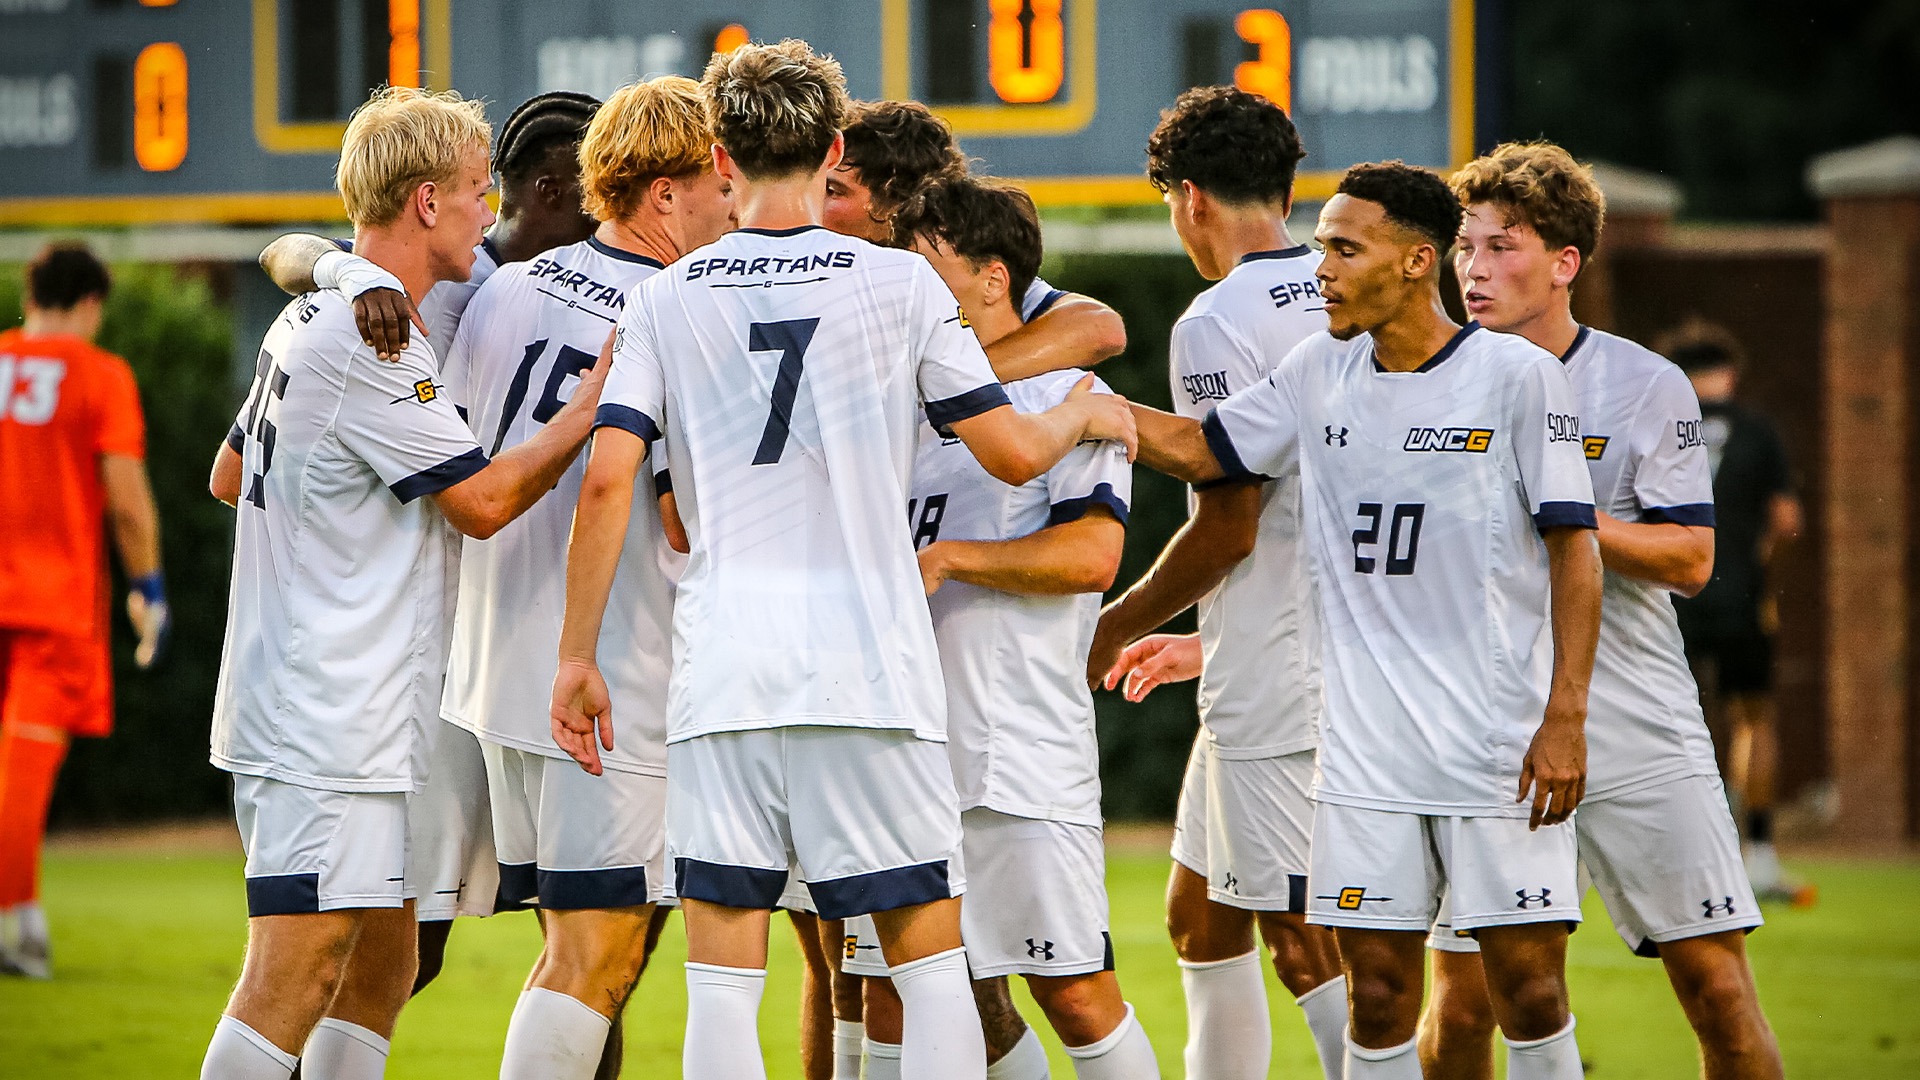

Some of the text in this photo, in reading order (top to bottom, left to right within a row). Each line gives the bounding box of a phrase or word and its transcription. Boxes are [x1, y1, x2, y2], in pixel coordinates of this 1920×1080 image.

[134, 42, 189, 171] 0
[527, 259, 626, 312] SPARTAN
[686, 251, 856, 282] SPARTANS
[749, 317, 821, 466] 7
[1403, 427, 1495, 453] UNCG
[1352, 502, 1425, 575] 20
